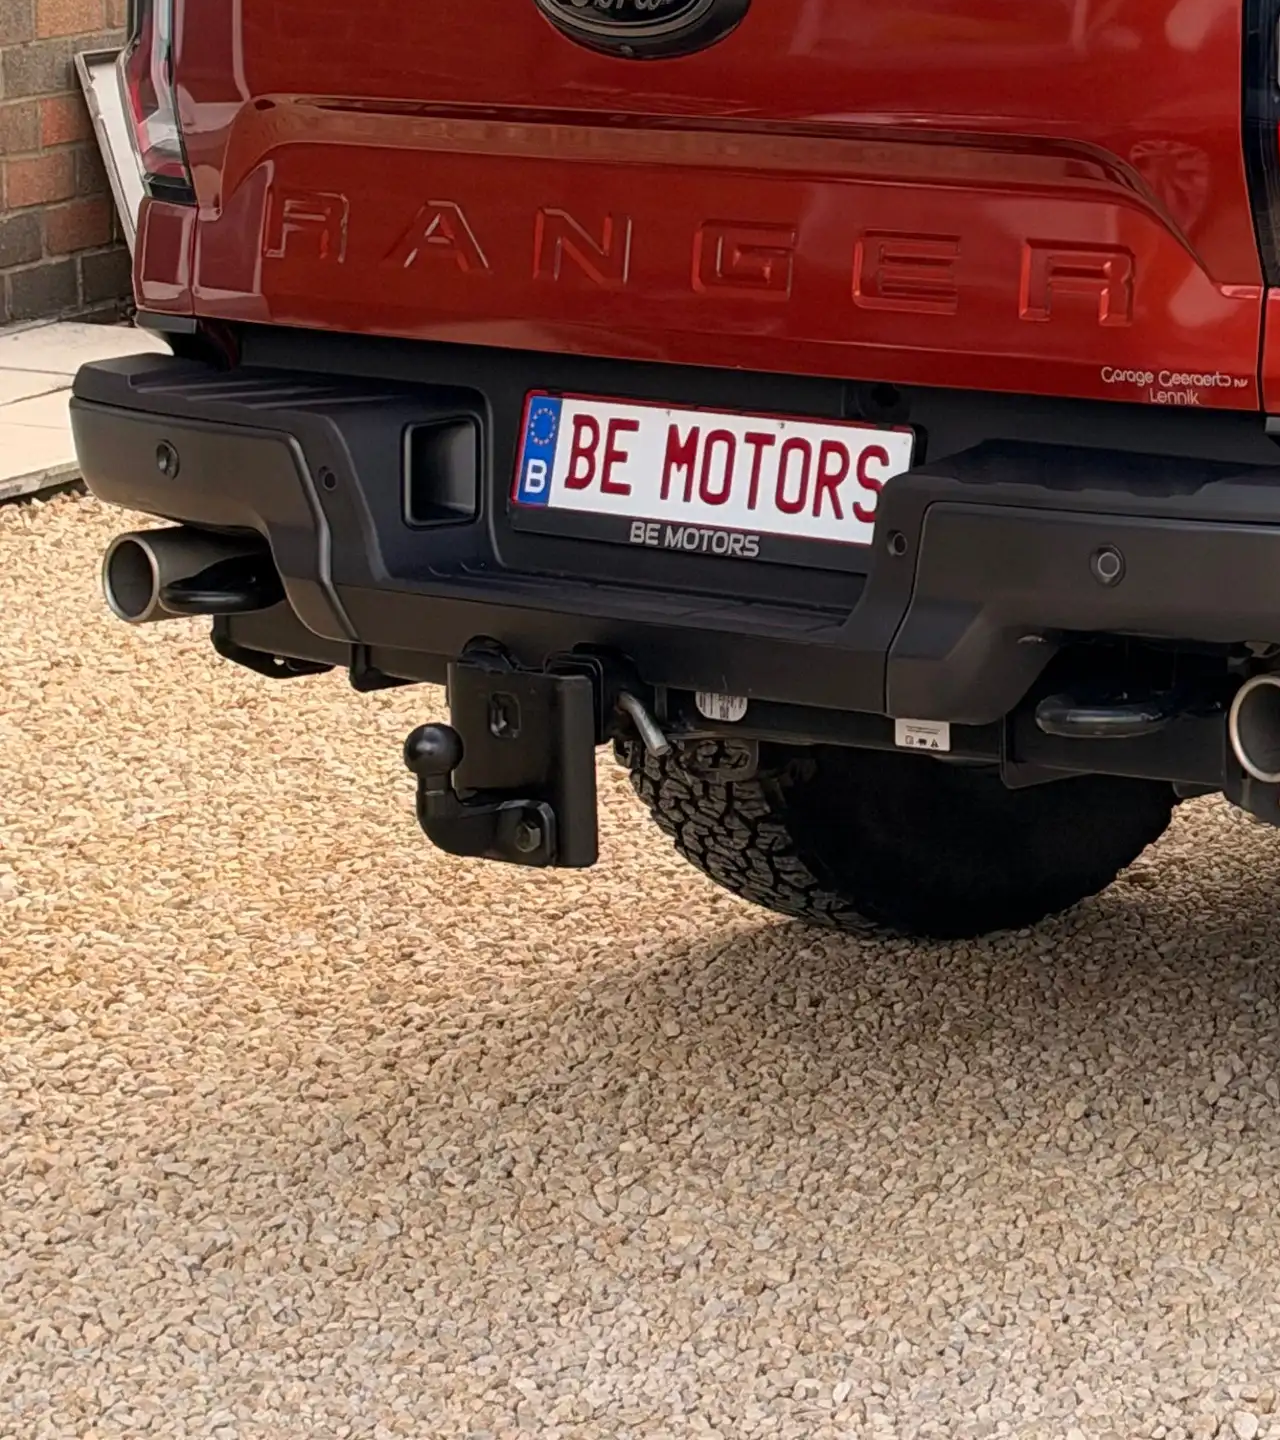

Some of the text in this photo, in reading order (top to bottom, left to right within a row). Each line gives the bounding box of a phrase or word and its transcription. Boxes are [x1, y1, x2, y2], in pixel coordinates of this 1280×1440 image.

[262, 190, 1137, 328] RANGER
[1101, 366, 1154, 387] Garage
[1149, 388, 1200, 405] Lennik
[524, 458, 547, 494] B
[564, 413, 890, 523] BE MOTORS
[629, 522, 761, 559] BE MOTORS
